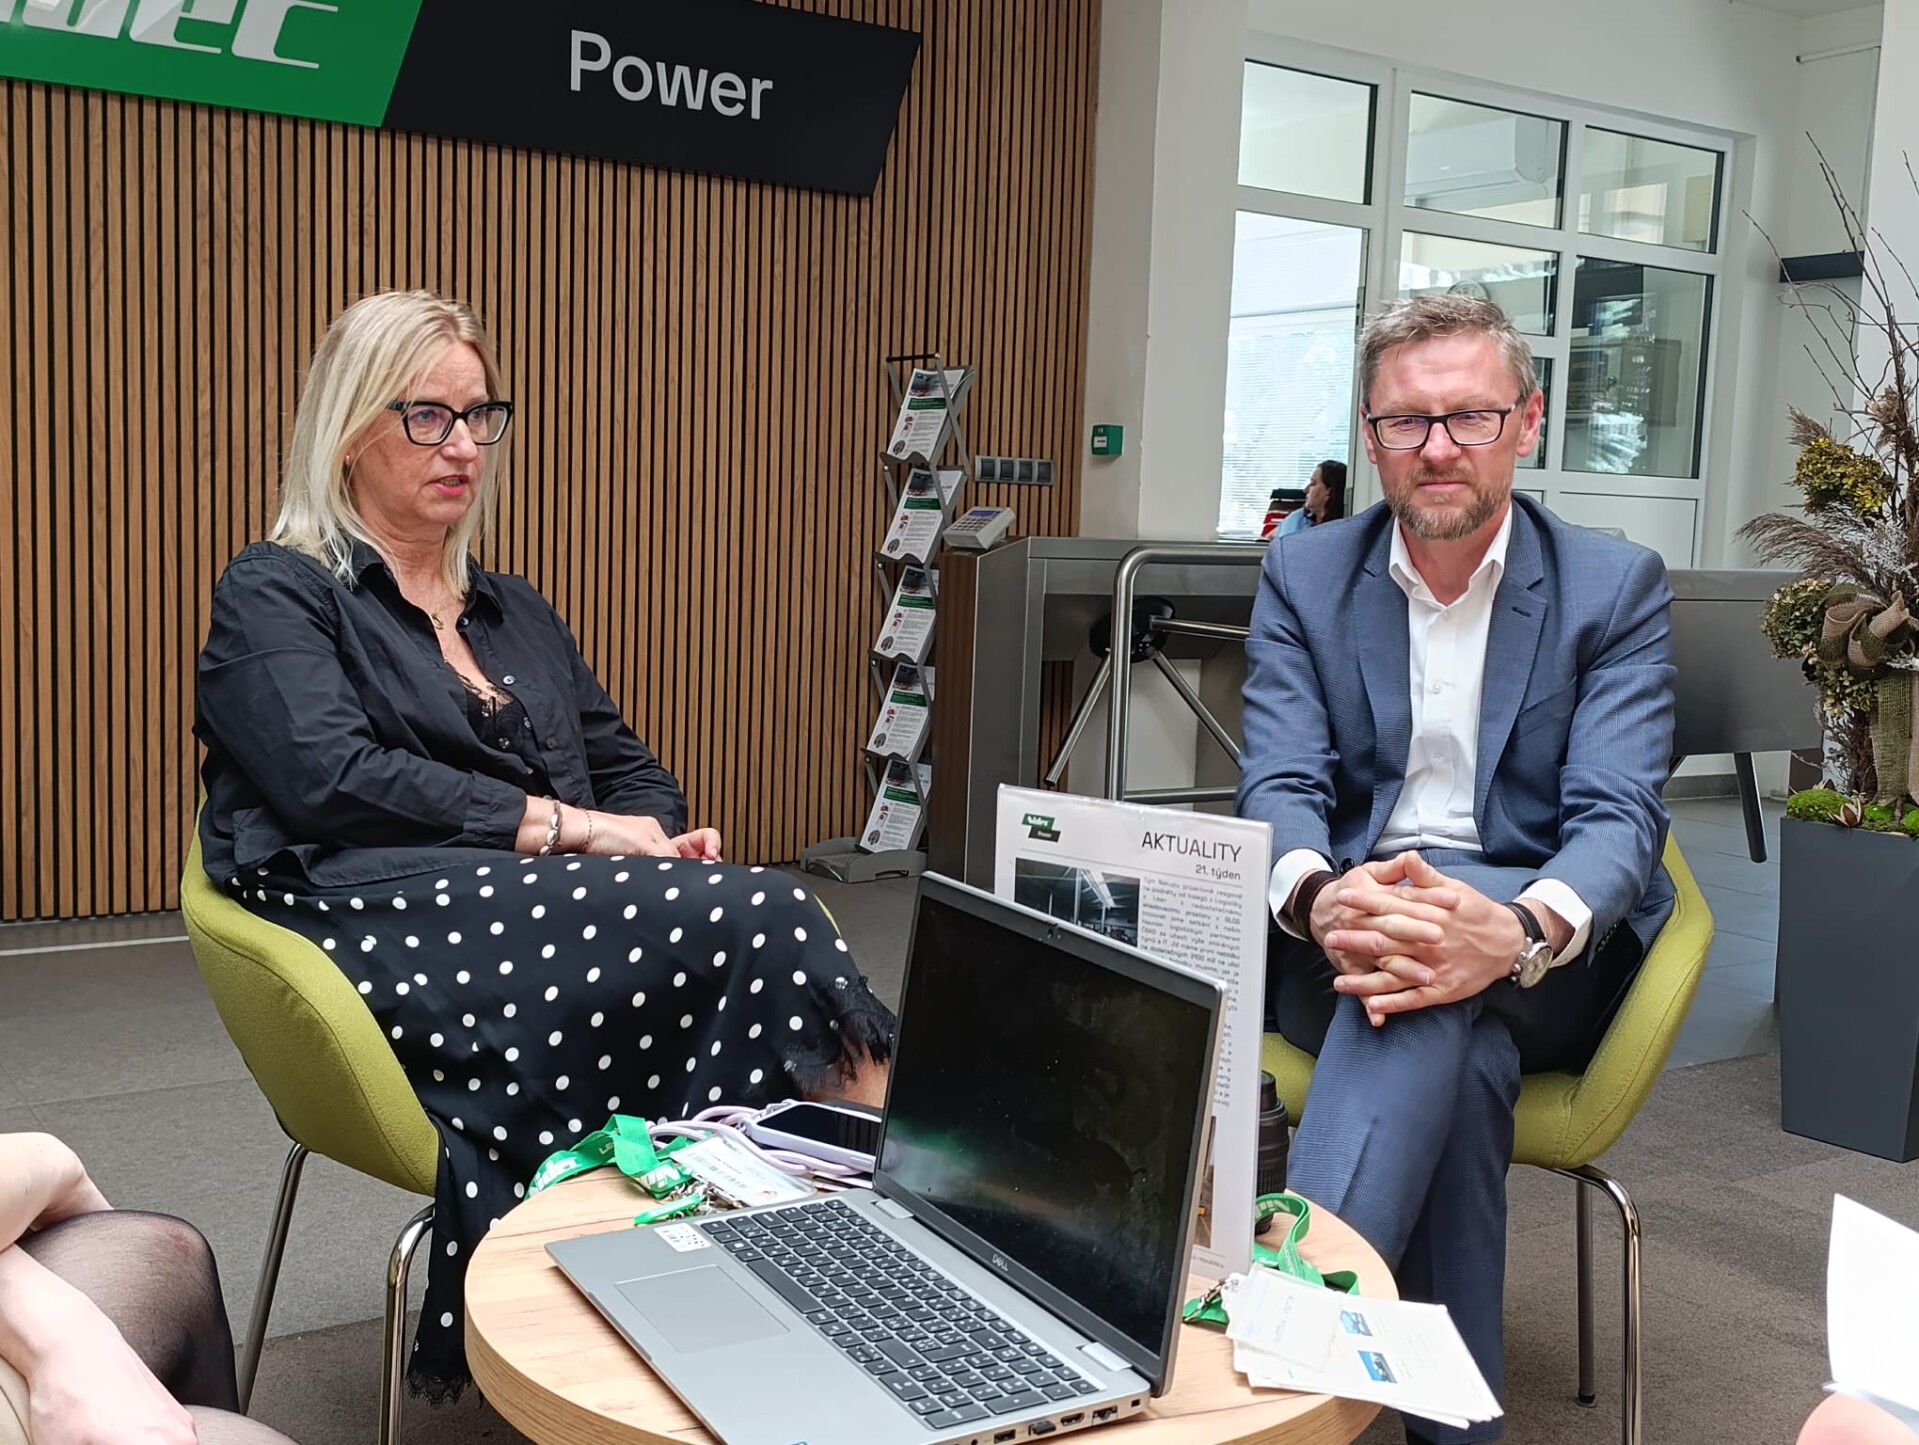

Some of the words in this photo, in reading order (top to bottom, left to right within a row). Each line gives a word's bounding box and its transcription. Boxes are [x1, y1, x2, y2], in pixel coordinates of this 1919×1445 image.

[568, 29, 775, 120] Power
[1141, 831, 1242, 863] AKTUALITY
[1195, 864, 1209, 876] 21.
[1211, 866, 1241, 881] týden
